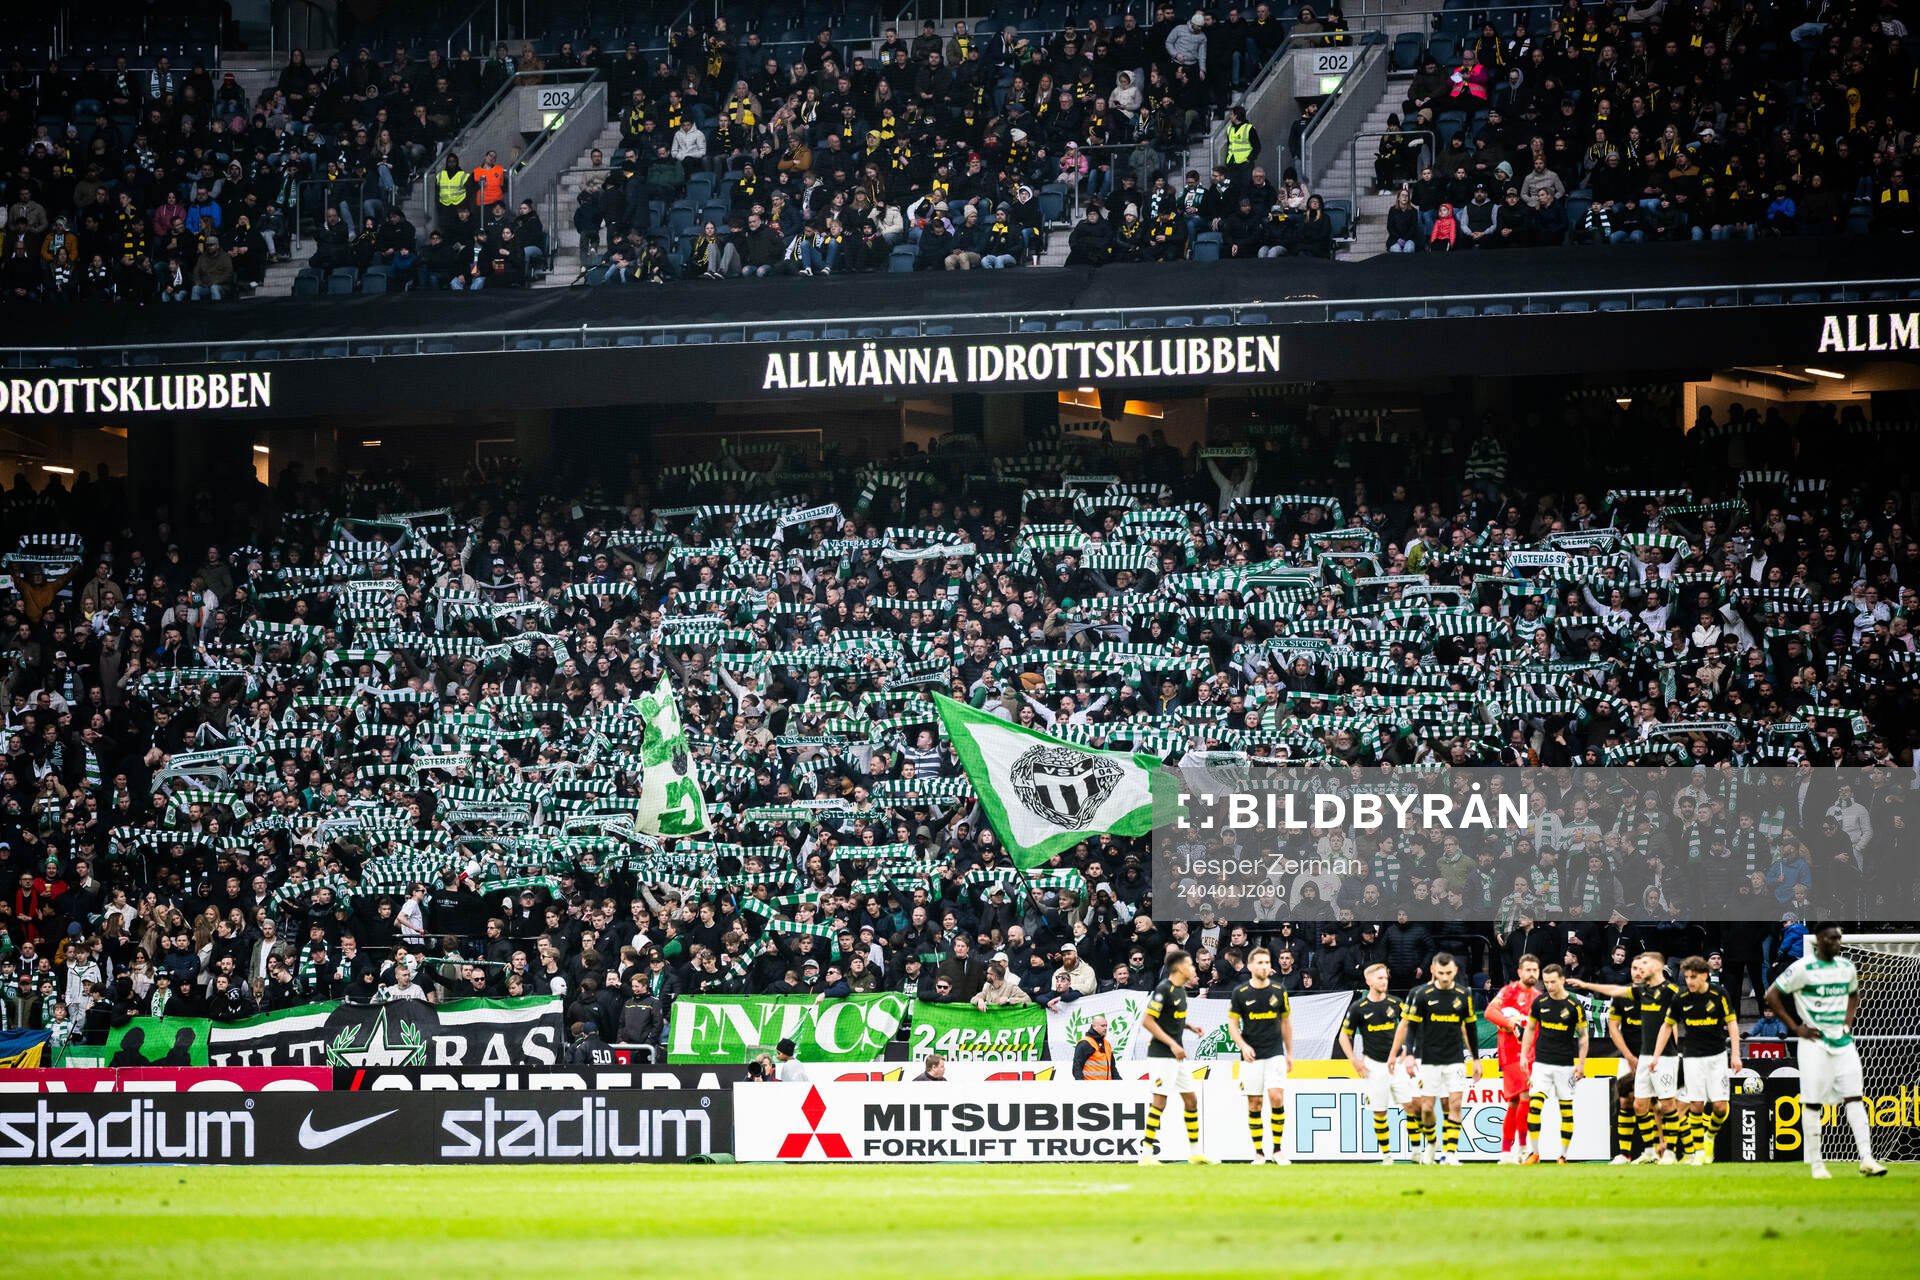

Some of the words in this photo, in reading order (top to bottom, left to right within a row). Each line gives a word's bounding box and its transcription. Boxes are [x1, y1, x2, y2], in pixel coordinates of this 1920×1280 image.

[1319, 56, 1348, 70] 202
[543, 92, 572, 106] 203
[763, 343, 957, 390] ALLMÄNNA
[966, 335, 1281, 382] IDROTTSKLUBBEN
[1512, 553, 1555, 564] VÄSTERÅS
[1044, 762, 1087, 778] VSK
[1098, 768, 1113, 776] 04
[671, 996, 909, 1057] FNTCS
[958, 1025, 1044, 1047] PARTY
[431, 1026, 556, 1066] RAS
[913, 1024, 961, 1057] 24
[591, 1049, 612, 1063] SLO
[441, 1097, 710, 1157] stadium
[863, 1103, 1160, 1131] MITSUBISH
[1741, 1108, 1755, 1160] SELECT
[863, 1138, 1018, 1157] FORKLIFT
[1027, 1138, 1162, 1157] TRUCKS
